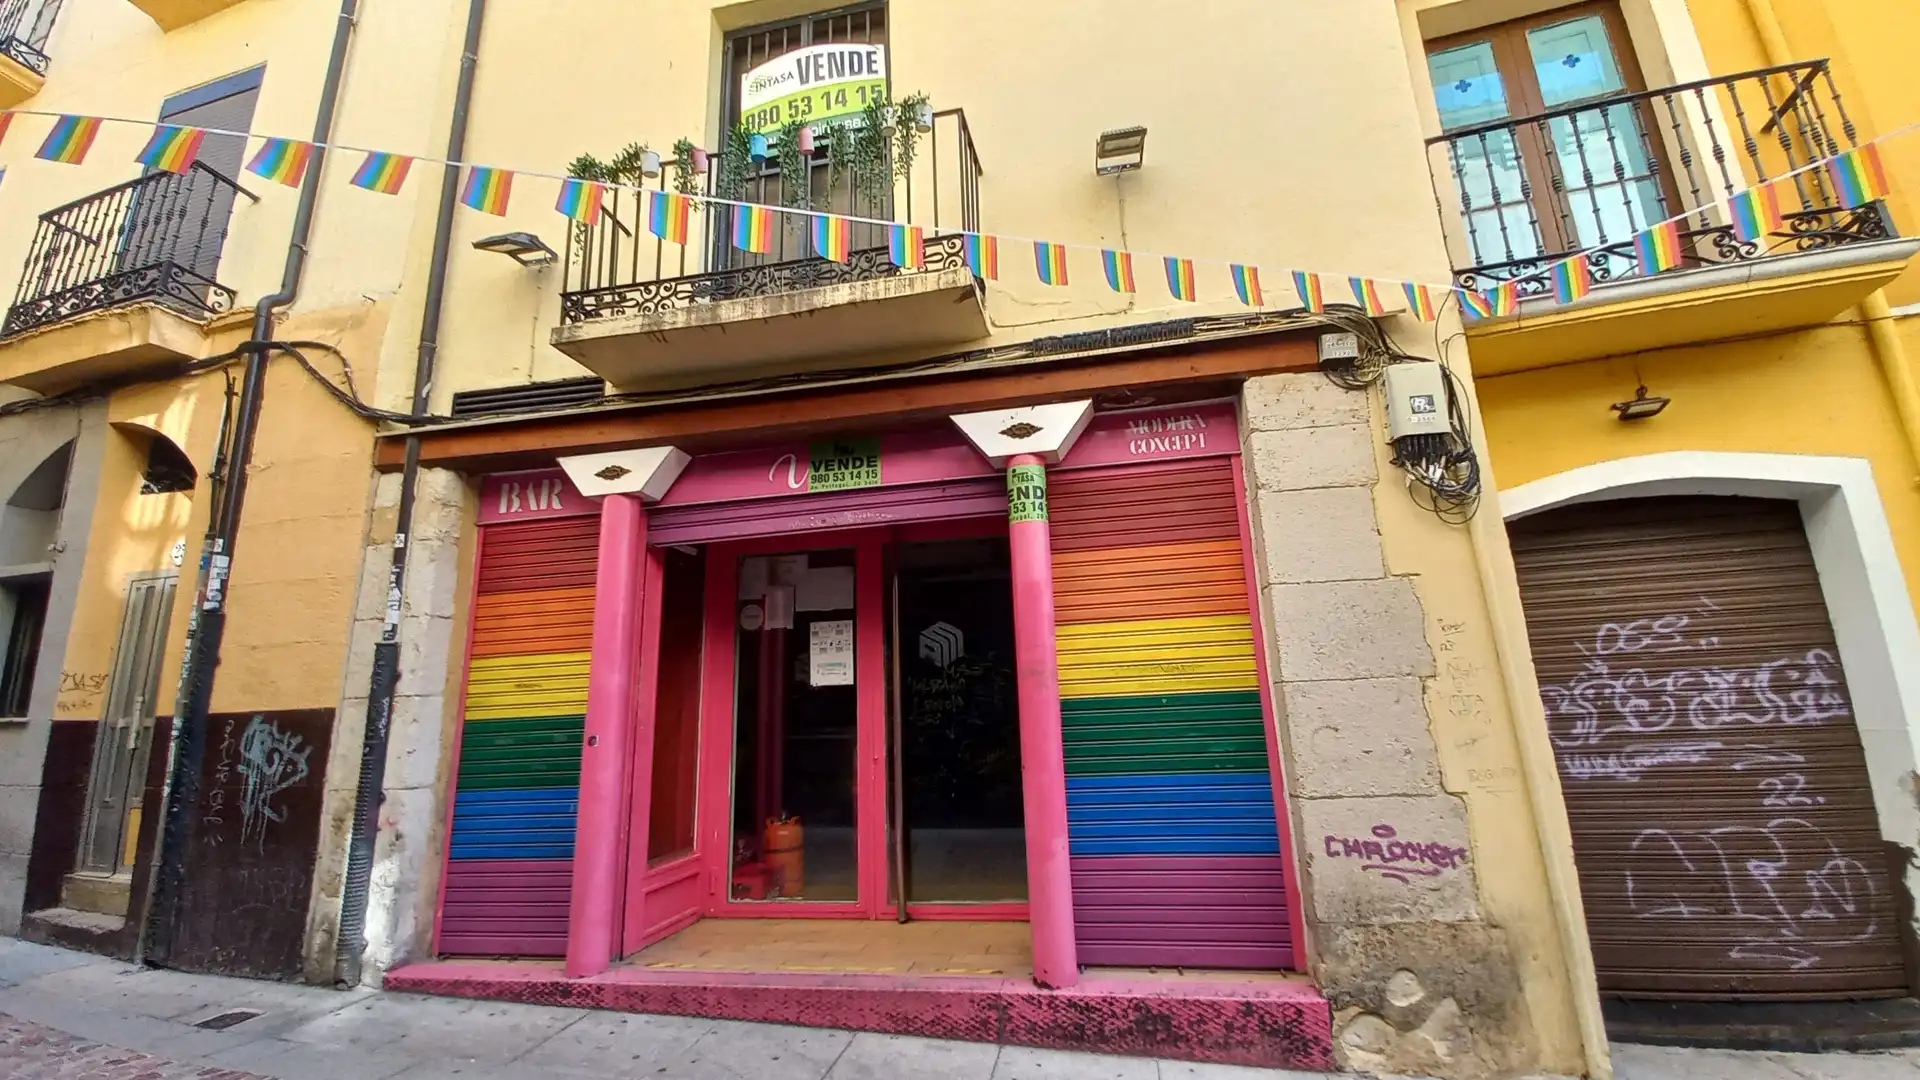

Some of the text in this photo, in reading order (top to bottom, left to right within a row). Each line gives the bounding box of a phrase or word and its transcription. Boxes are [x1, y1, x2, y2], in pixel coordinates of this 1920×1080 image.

[797, 50, 879, 85] VENDE
[746, 84, 883, 131] 980 53 14 15
[1129, 432, 1207, 454] CONCEPT
[811, 455, 878, 474] VENDE
[811, 469, 878, 484] 980 53 14 15
[498, 479, 563, 514] BAR
[1013, 501, 1044, 514] 53 14
